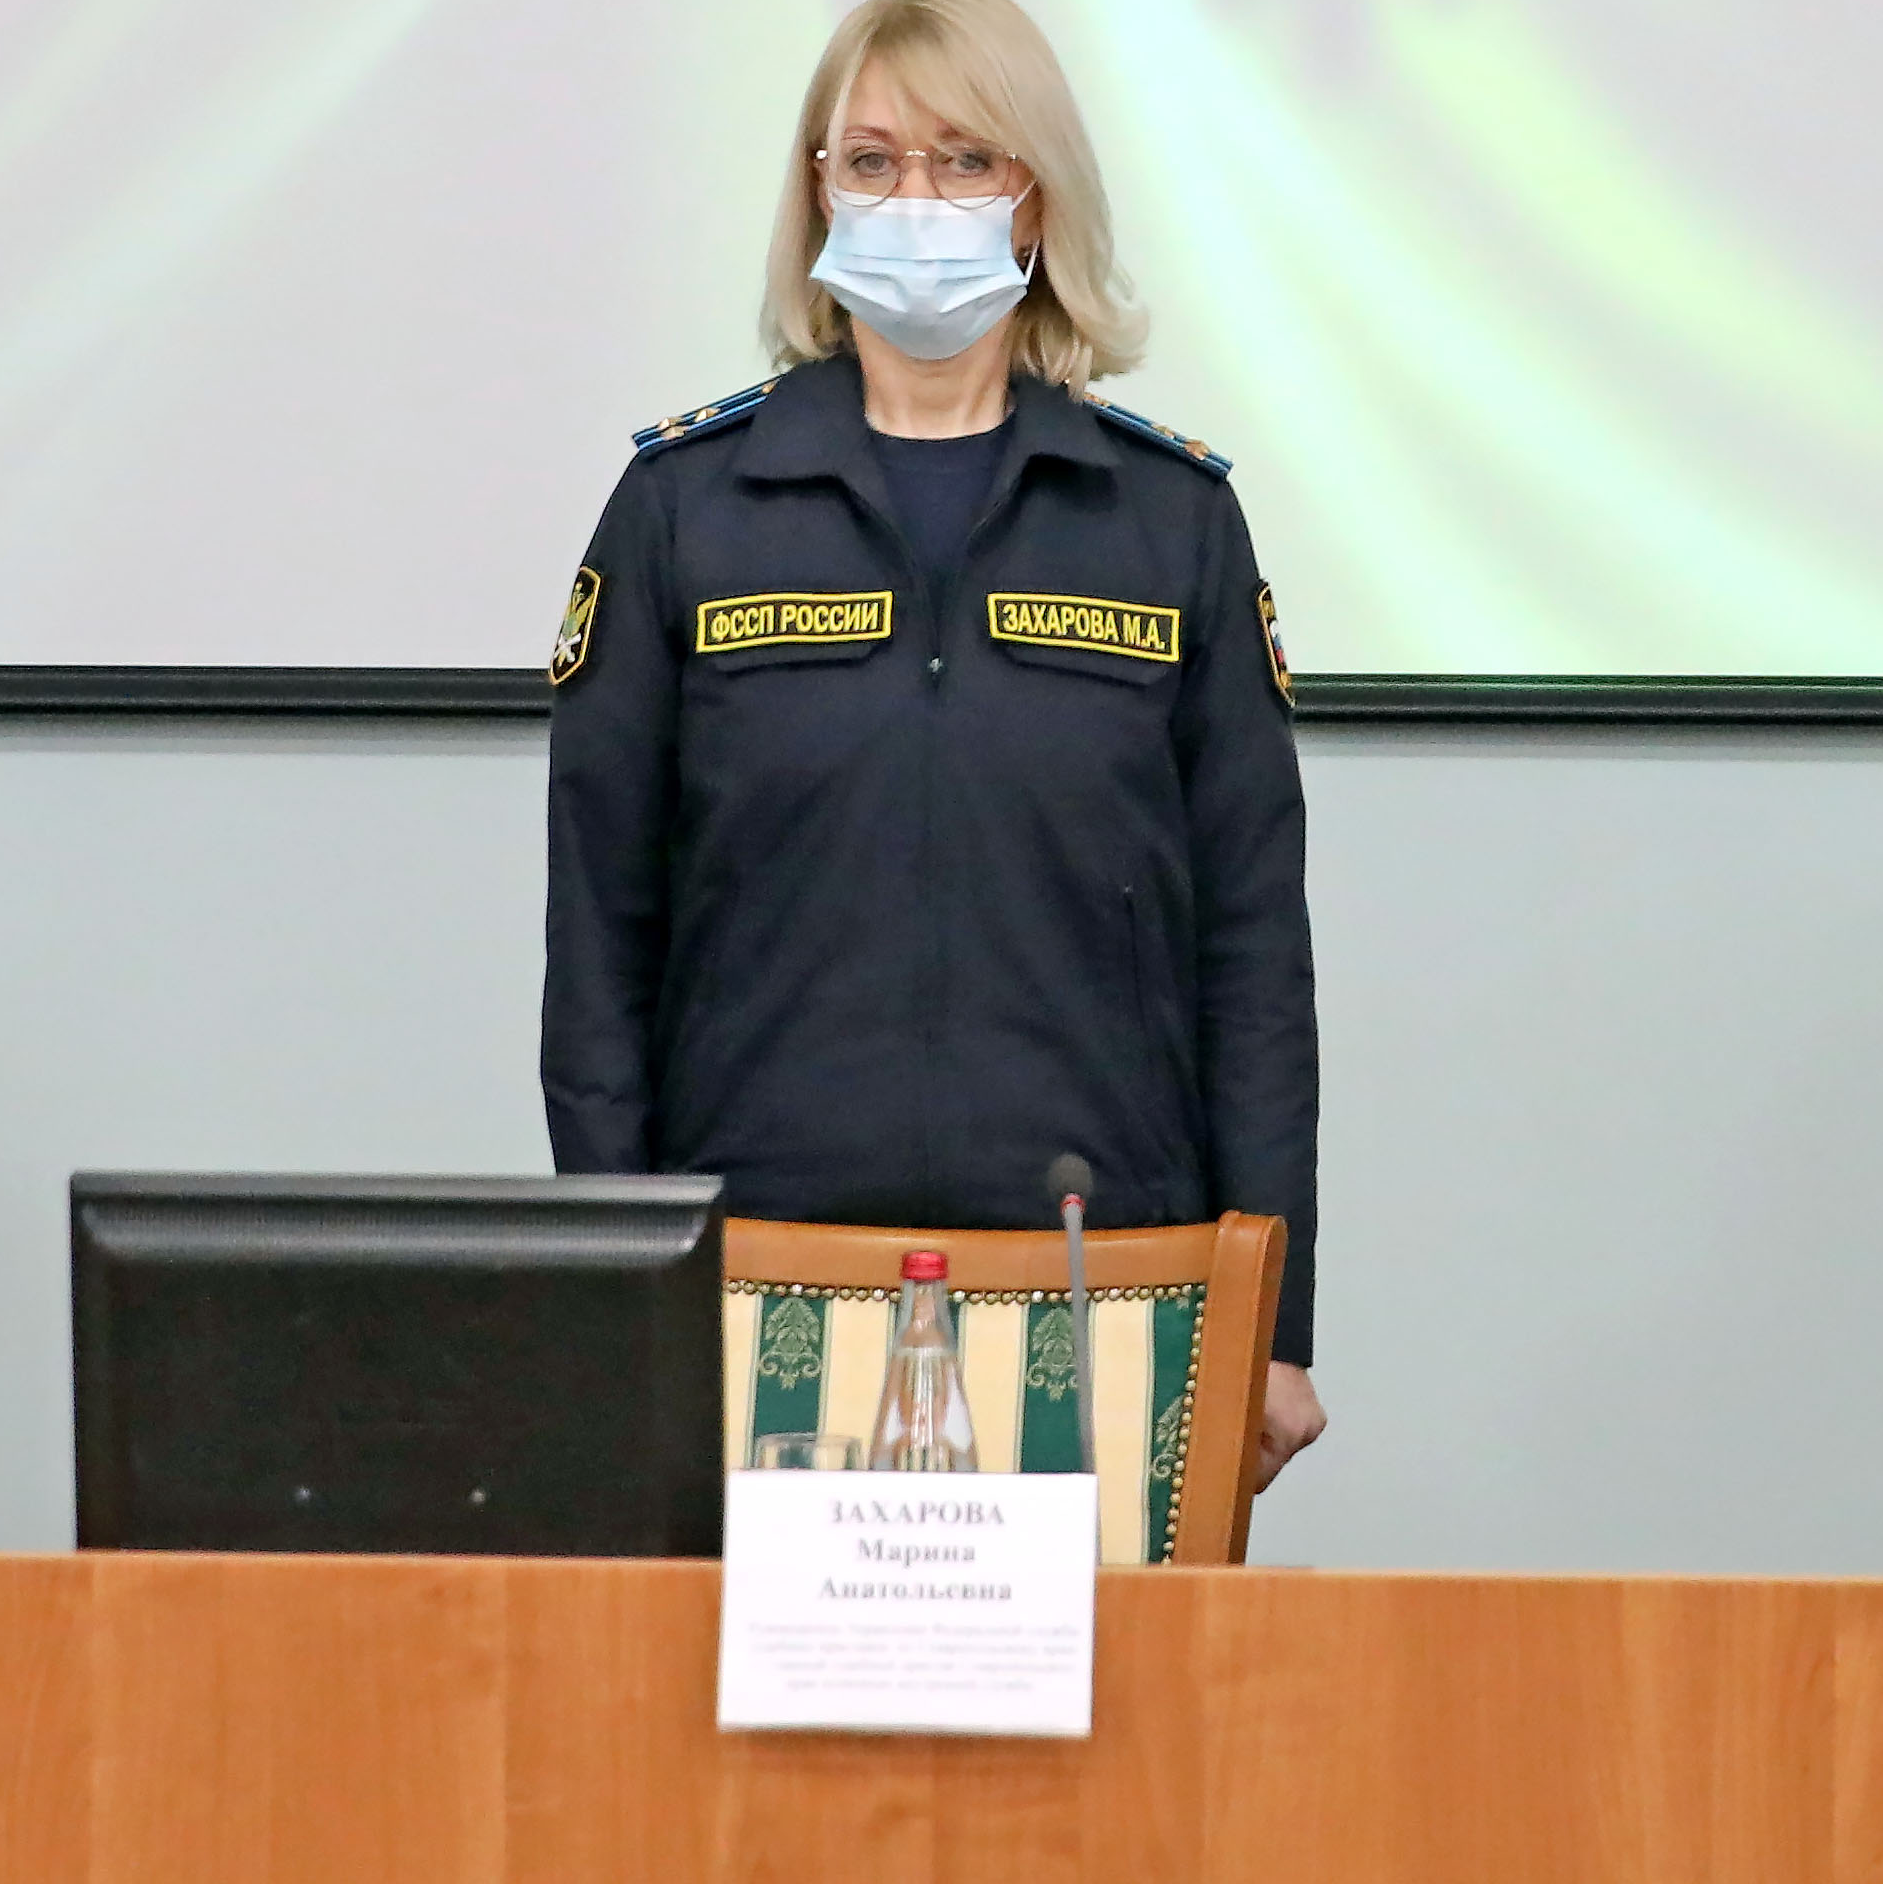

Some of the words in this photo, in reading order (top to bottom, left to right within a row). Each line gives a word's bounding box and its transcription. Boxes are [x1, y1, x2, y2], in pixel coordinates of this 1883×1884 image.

[711, 605, 775, 641] ФССП
[780, 602, 879, 633] РОССИИ
[1002, 602, 1119, 641] ЗАХАРОВА
[1123, 613, 1167, 649] М.А.
[857, 1538, 977, 1568] Марина
[819, 1576, 1013, 1603] Анатольевна
